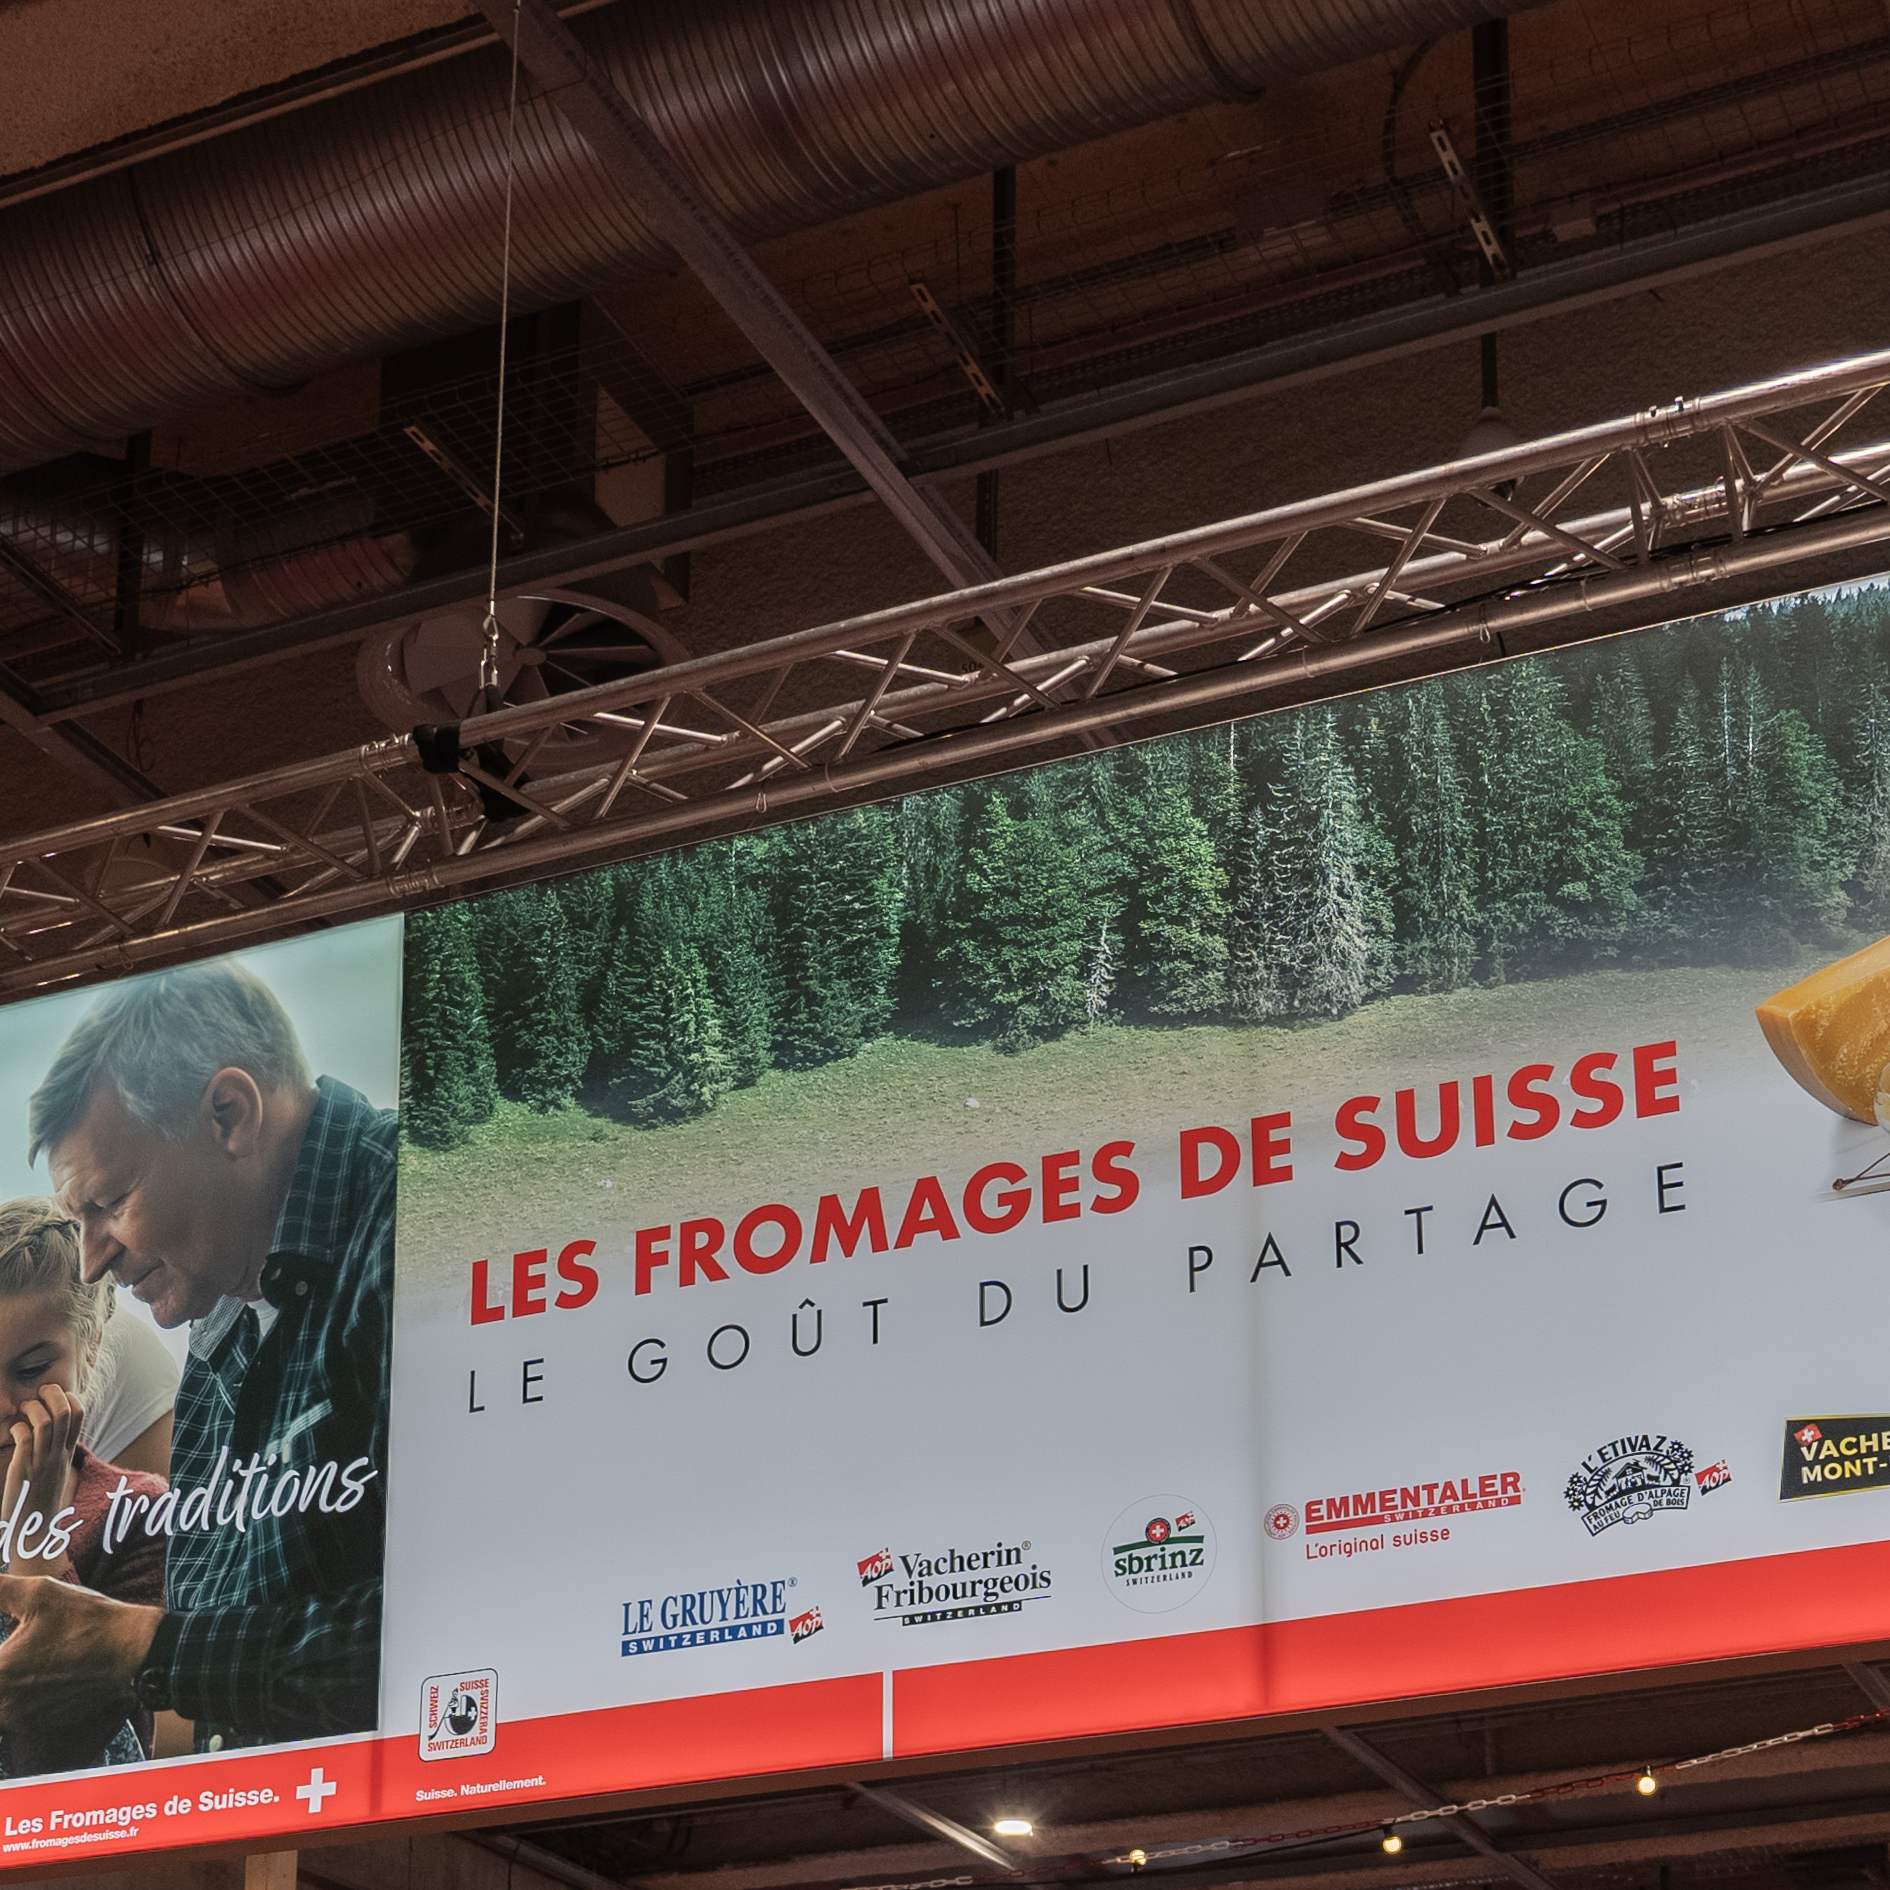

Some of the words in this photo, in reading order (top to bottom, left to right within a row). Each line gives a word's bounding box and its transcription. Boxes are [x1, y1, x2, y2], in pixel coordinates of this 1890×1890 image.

[470, 1239, 599, 1326] LES
[634, 1140, 1140, 1296] FROMAGES
[1179, 1111, 1294, 1200] DE
[1333, 1040, 1681, 1172] SUISSE
[468, 1358, 546, 1413] LE
[627, 1298, 889, 1384] GOÛT
[978, 1264, 1091, 1327] DU
[1188, 1162, 1686, 1293] PARTAGE
[1581, 1434, 1668, 1475] L'ETIVAZ
[102, 1445, 378, 1555] traditions
[1305, 1471, 1521, 1524] EMMENTALER
[1383, 1498, 1510, 1524] SWITZERLAND
[1586, 1494, 1634, 1525] FROMAGE
[1637, 1488, 1686, 1502] D'ALPAGE
[1592, 1520, 1604, 1531] AU
[1604, 1511, 1621, 1525] FEU
[1653, 1499, 1664, 1508] DE
[1393, 1528, 1450, 1547] suisse
[899, 1543, 1023, 1580] Vacherin
[1114, 1546, 1204, 1577] sbrinz
[1126, 1571, 1193, 1587] SWITZERLAND
[873, 1565, 1052, 1611] Fribourgeois
[622, 1600, 653, 1637] LE
[659, 1578, 788, 1632] GRUYÈRE
[903, 1601, 1023, 1625] SWITZERLAND
[627, 1620, 781, 1654] SWITZERLAND
[459, 1678, 490, 1692] SUISSE
[428, 1685, 439, 1729] SCHWEIZ
[478, 1689, 489, 1734] SVIZZERA
[427, 1735, 488, 1752] SWITZERLAND
[416, 1788, 458, 1802] Suisse.
[460, 1774, 547, 1796] Naturellement.
[4, 1816, 44, 1837] Les
[50, 1802, 157, 1832] Fromages
[163, 1796, 192, 1816] de
[198, 1785, 281, 1812] Suisse.
[2, 1826, 140, 1854] www.fromagesdesuisse.fr
